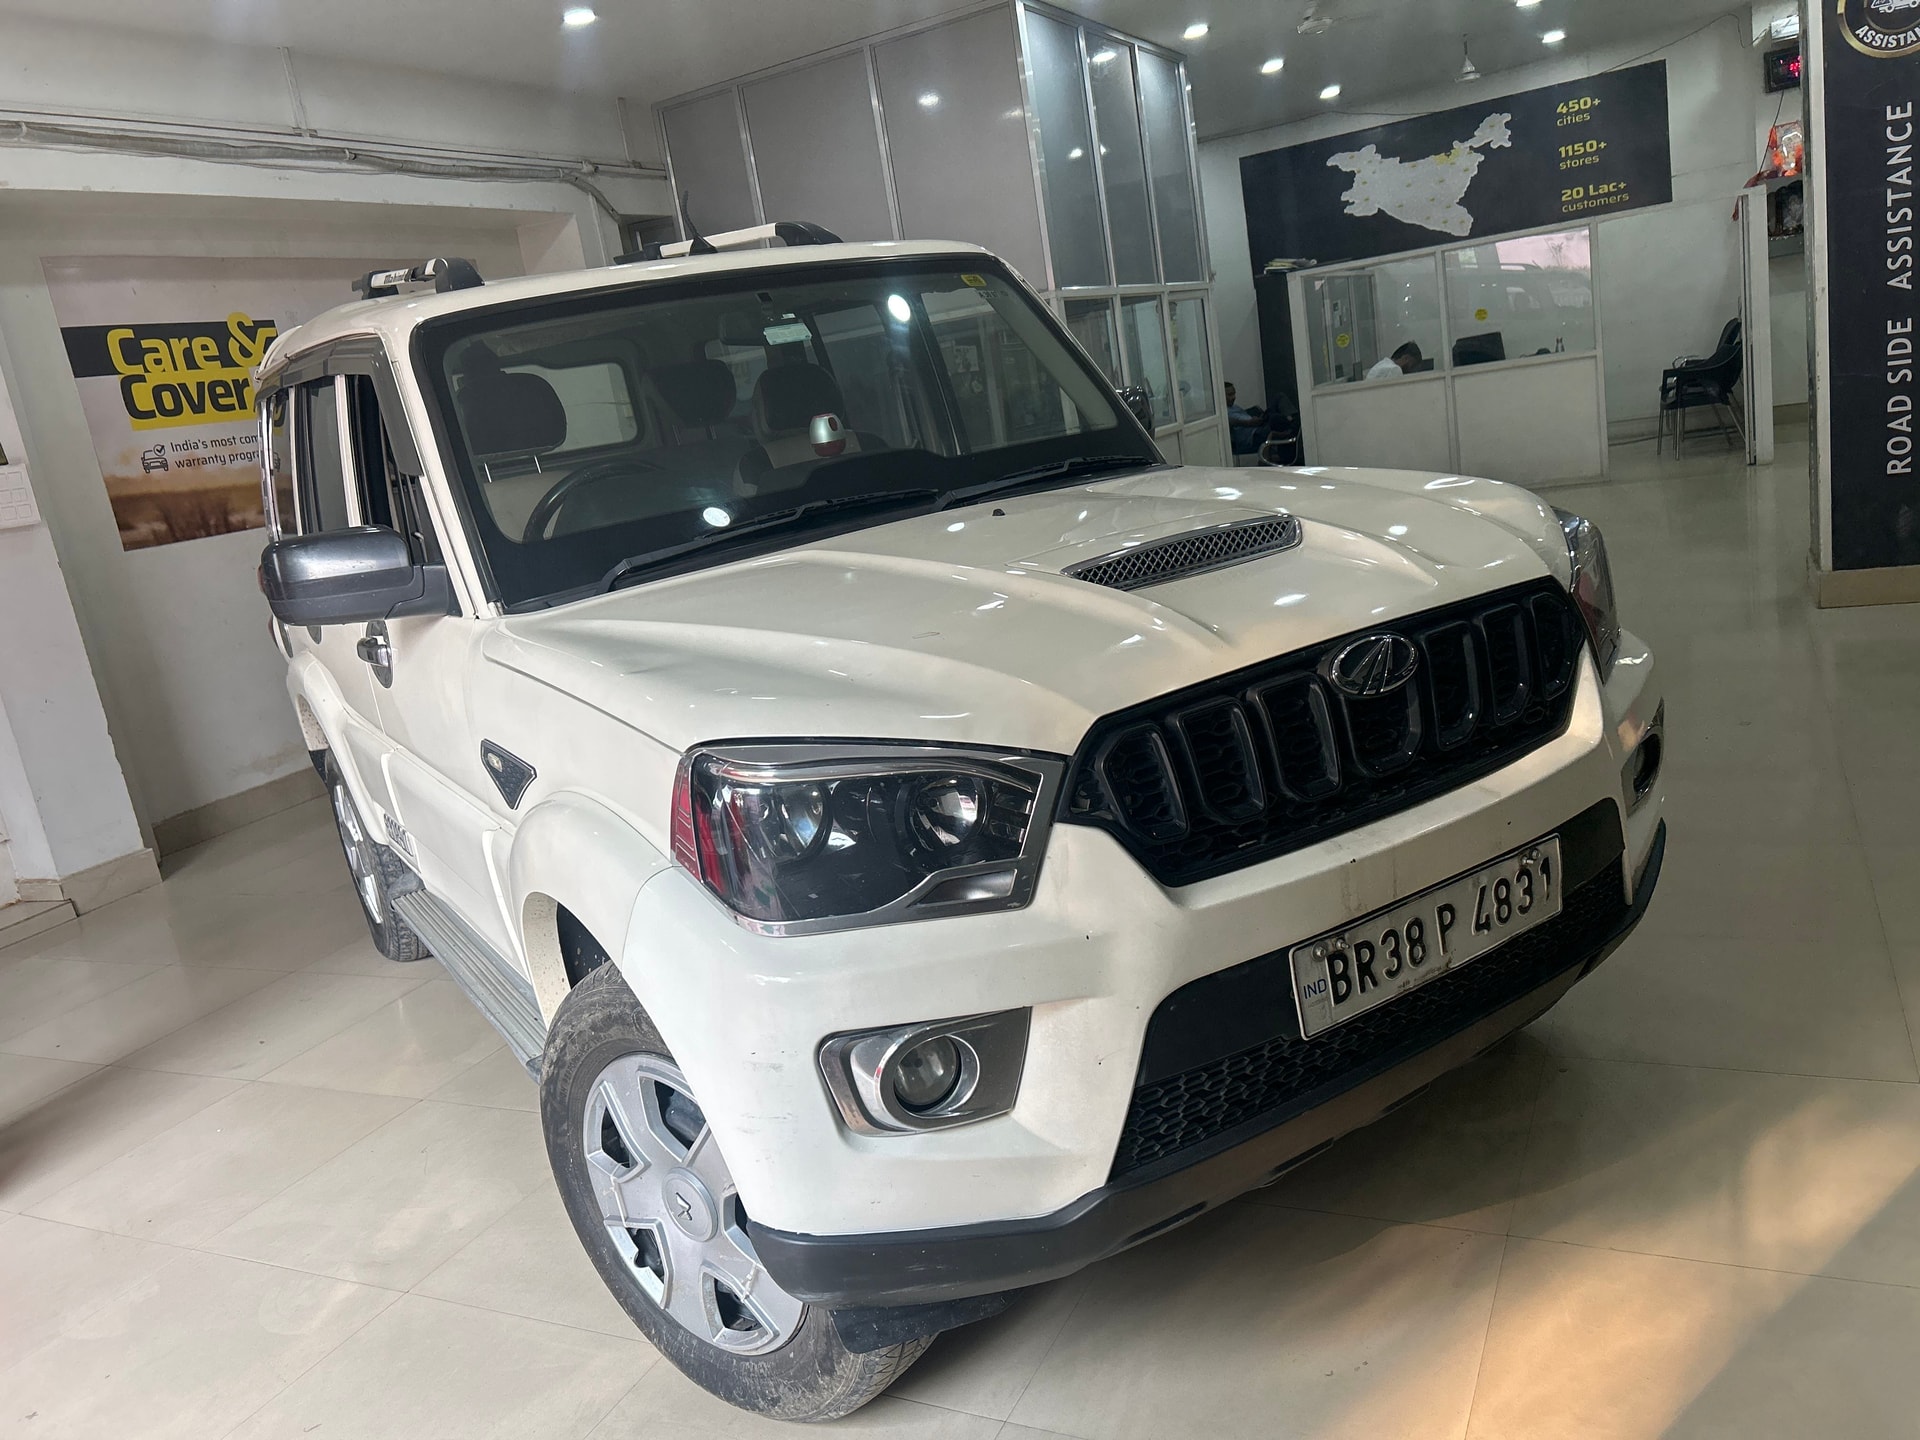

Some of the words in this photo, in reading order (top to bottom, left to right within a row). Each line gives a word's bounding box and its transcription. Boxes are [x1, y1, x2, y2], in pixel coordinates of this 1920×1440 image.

[1556, 96, 1601, 114] 450+
[1556, 112, 1591, 127] cities
[1558, 139, 1607, 158] 1150+
[1559, 155, 1600, 170] stores
[1561, 186, 1584, 202] 20
[1589, 181, 1627, 197] Lac+
[1886, 101, 1913, 290] ASSISTANCE
[1562, 192, 1630, 213] customers
[106, 328, 223, 375] Care
[227, 312, 278, 368] &
[1886, 317, 1913, 384] SIDE
[170, 438, 209, 453] India's
[210, 435, 237, 448] most
[1886, 395, 1913, 475] ROAD
[174, 454, 227, 469] warranty
[1325, 916, 1427, 1008] BR38
[1434, 903, 1456, 957] P
[1471, 856, 1552, 936] 4831
[1303, 978, 1327, 1000] IND
